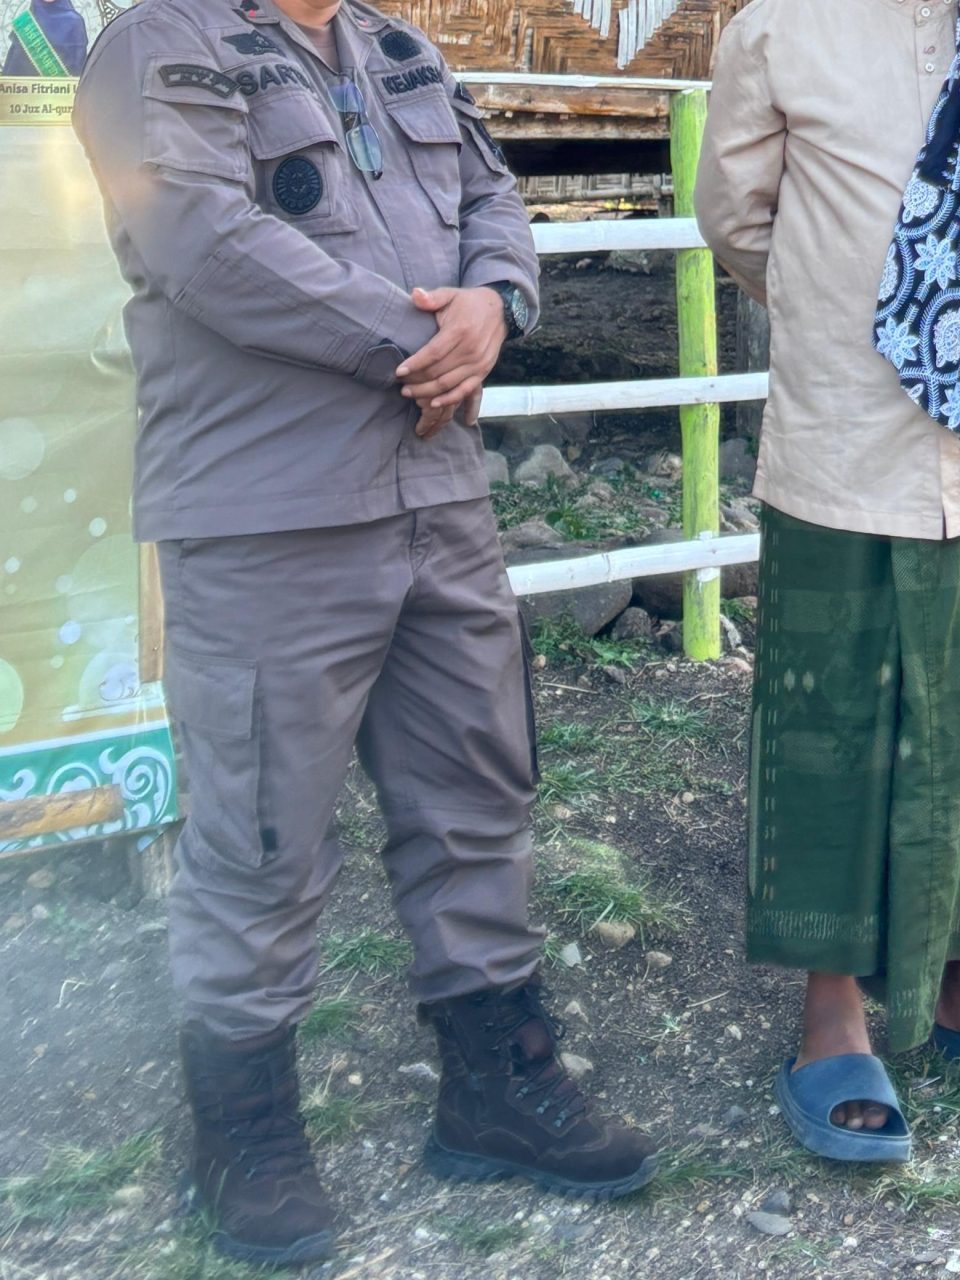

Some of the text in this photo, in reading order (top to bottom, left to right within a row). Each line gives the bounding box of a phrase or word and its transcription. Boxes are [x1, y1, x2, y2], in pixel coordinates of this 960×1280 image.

[0, 83, 28, 94] Anisa
[31, 83, 70, 94] Fitriani
[10, 104, 74, 115] 10 Juz Al-qur
